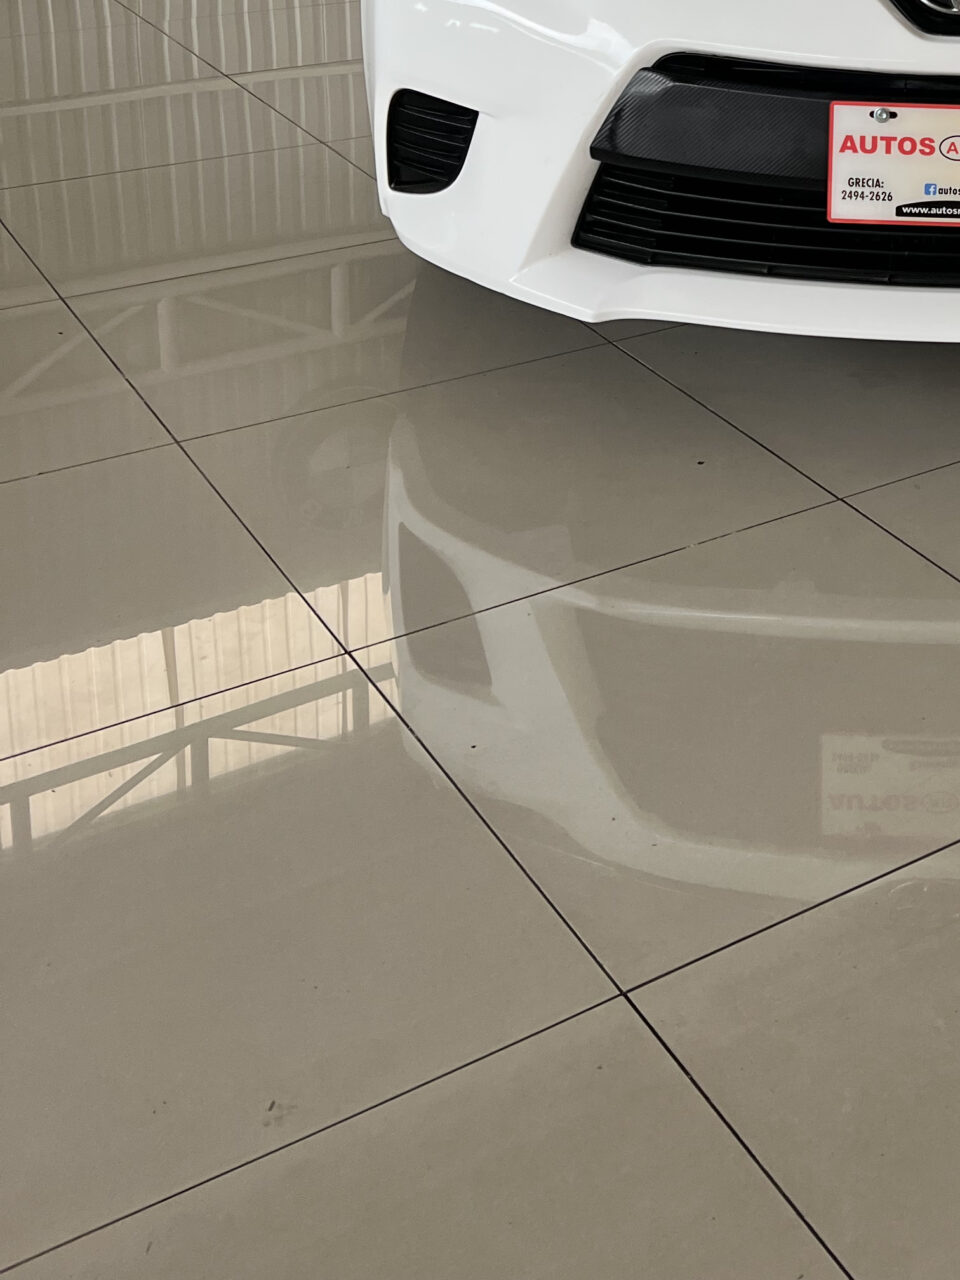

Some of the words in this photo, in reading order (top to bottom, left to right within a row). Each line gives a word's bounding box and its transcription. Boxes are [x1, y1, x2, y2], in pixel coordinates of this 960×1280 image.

[839, 134, 936, 156] AUTOS
[847, 177, 885, 188] GRECIA:
[841, 190, 893, 202] 2494-2626
